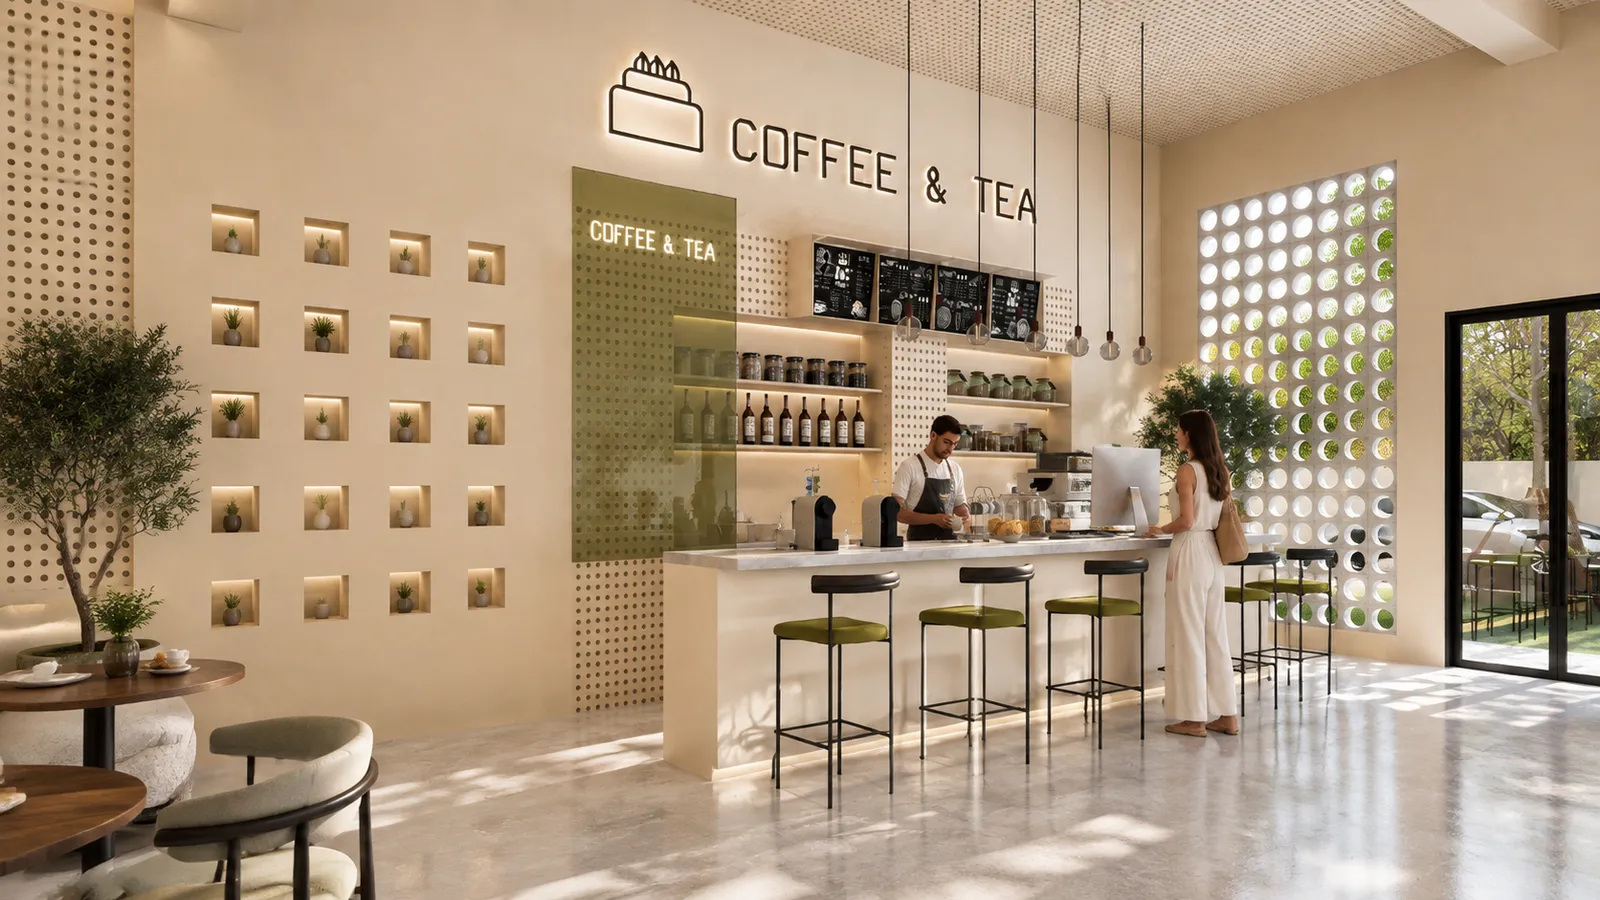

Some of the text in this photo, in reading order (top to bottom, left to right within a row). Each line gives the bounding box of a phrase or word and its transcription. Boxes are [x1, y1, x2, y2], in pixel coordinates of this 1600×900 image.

[732, 118, 1037, 224] COFFEE & TEA
[590, 220, 716, 262] COFFEE & TEA
